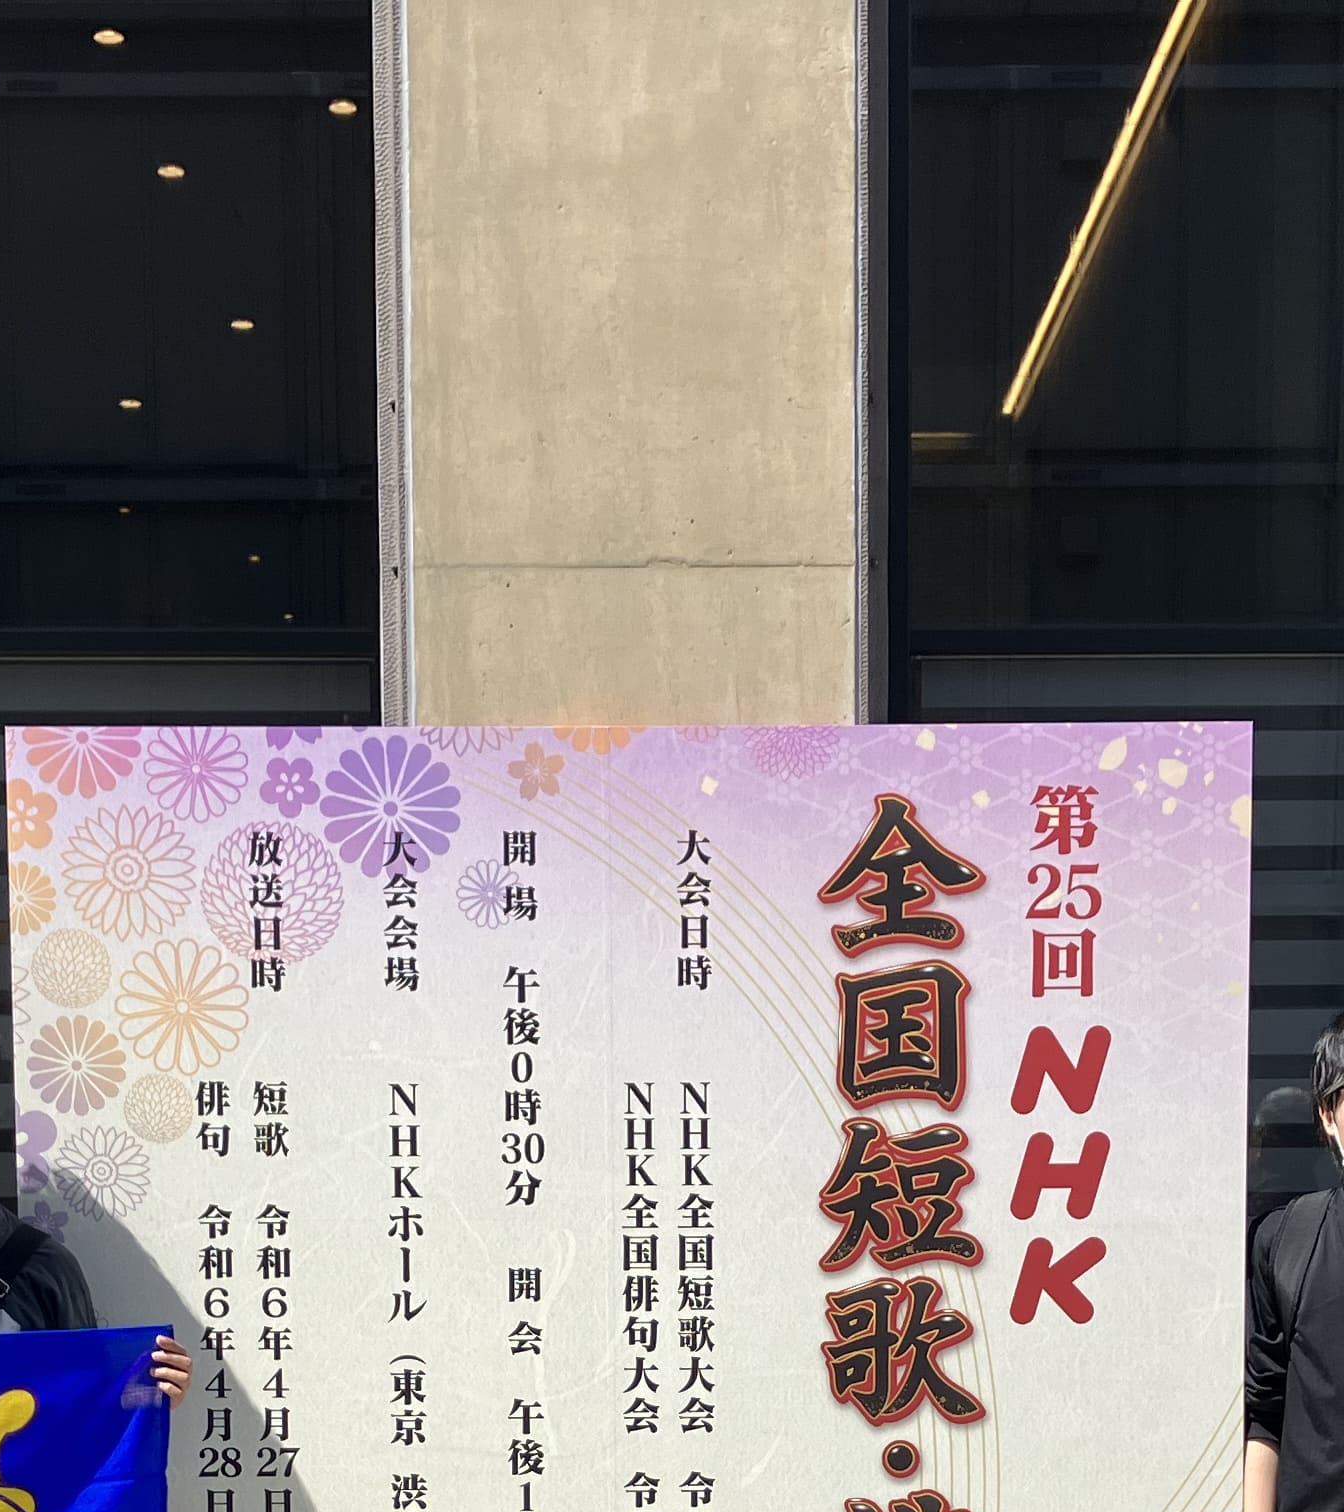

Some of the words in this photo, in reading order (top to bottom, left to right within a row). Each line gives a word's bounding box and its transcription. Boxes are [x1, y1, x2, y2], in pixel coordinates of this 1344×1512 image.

[248, 831, 285, 992] 放送日時
[383, 831, 419, 991] 大会会場
[503, 831, 537, 921] 開場
[677, 830, 712, 990] 大会日時
[1024, 784, 1103, 998] 第25回
[196, 1081, 230, 1157] 俳句
[254, 1081, 289, 1156] 短歌
[502, 966, 544, 1205] 午後0時30分
[388, 1084, 427, 1322] NHKホール
[1009, 1024, 1112, 1325] NHK
[508, 1268, 542, 1355] 開会
[622, 1083, 659, 1433] NHK全国俳句大会
[678, 1082, 715, 1433] NHK全国短歌大会
[390, 1355, 426, 1445] (東京
